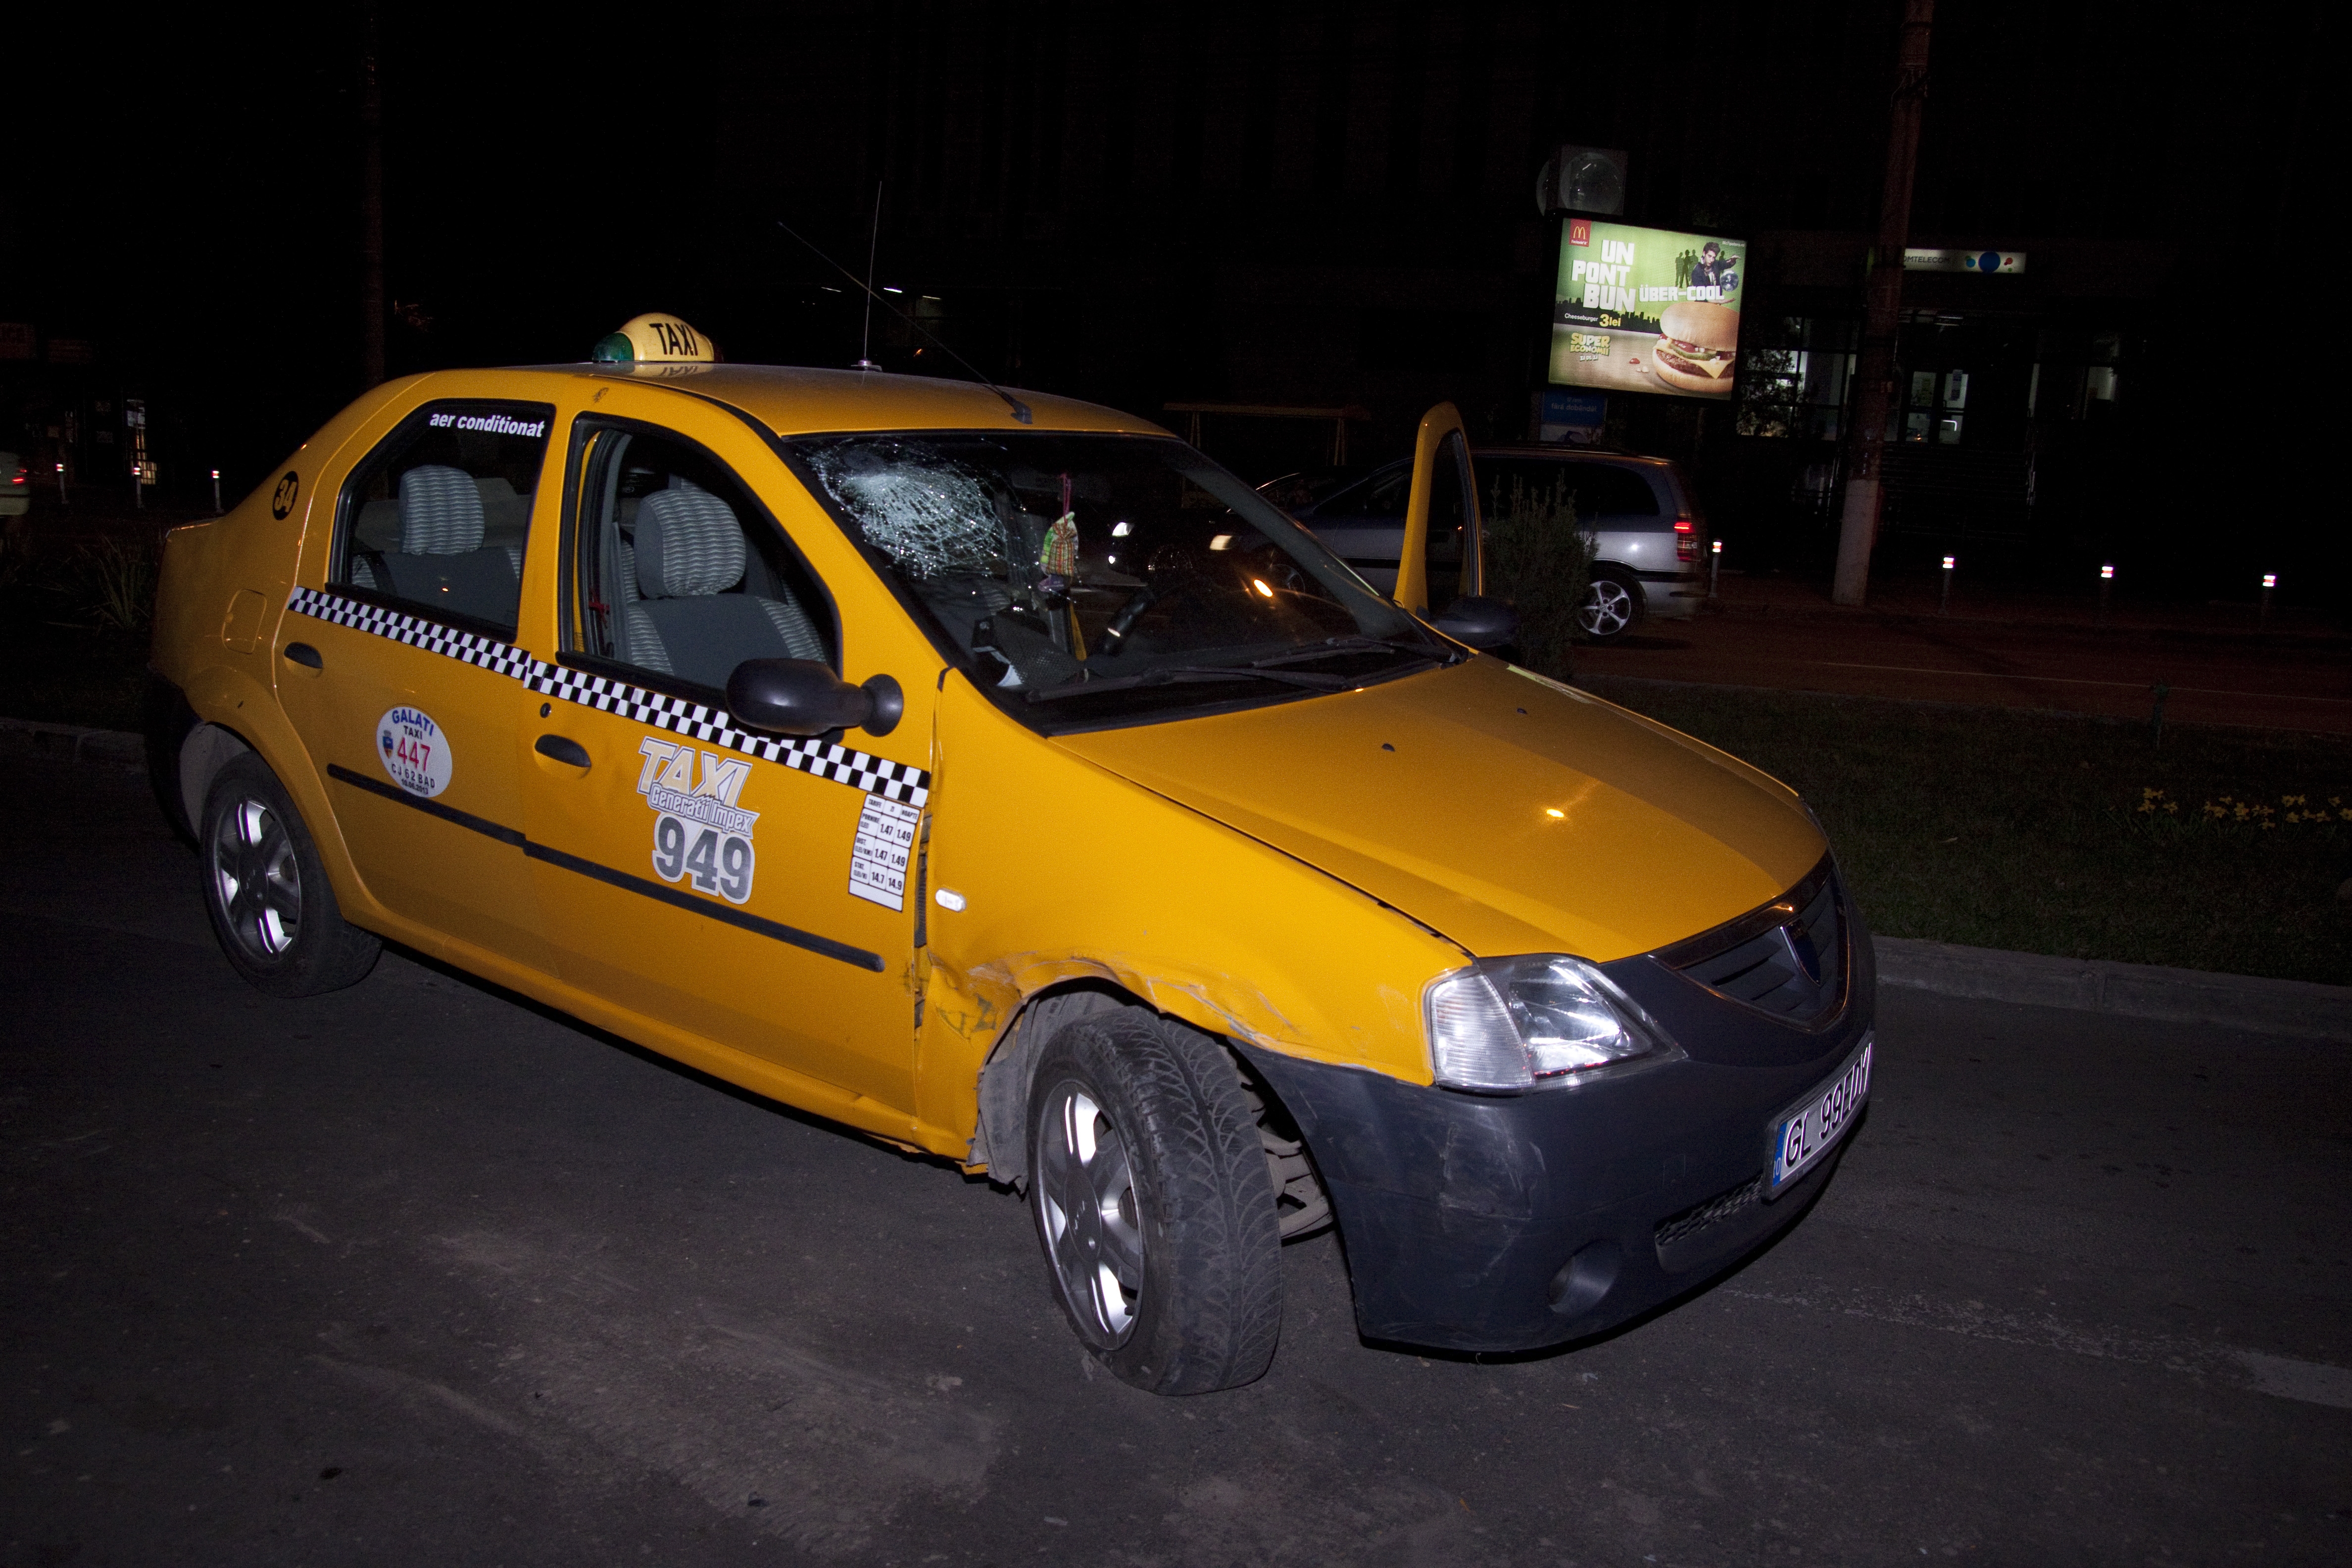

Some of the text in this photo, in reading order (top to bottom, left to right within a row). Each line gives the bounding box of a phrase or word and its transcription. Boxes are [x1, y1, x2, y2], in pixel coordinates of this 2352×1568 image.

[1601, 239, 1635, 265] UN
[1571, 259, 1630, 287] PONT
[1583, 283, 1725, 313] BUN ÜBER-COOL
[1565, 313, 1598, 322] Cheeseburger
[648, 323, 698, 356] TAXI
[1570, 332, 1611, 347] SUPER
[1570, 344, 1610, 356] ECONOMII
[429, 413, 544, 438] aer conditionat
[274, 479, 297, 512] 34
[392, 709, 434, 736] GALATI
[403, 725, 423, 740] TAXI
[397, 736, 431, 772] 447
[637, 735, 753, 808] TAXI
[650, 784, 754, 835] Generatii Impex
[881, 824, 893, 836] 1.47
[897, 829, 912, 842] 1.49
[654, 814, 754, 903] 949
[875, 848, 888, 861] 1.47
[891, 854, 906, 867] 1.49
[872, 872, 884, 884] 14.7
[888, 878, 902, 890] 14.9
[1784, 1110, 1812, 1168] GL
